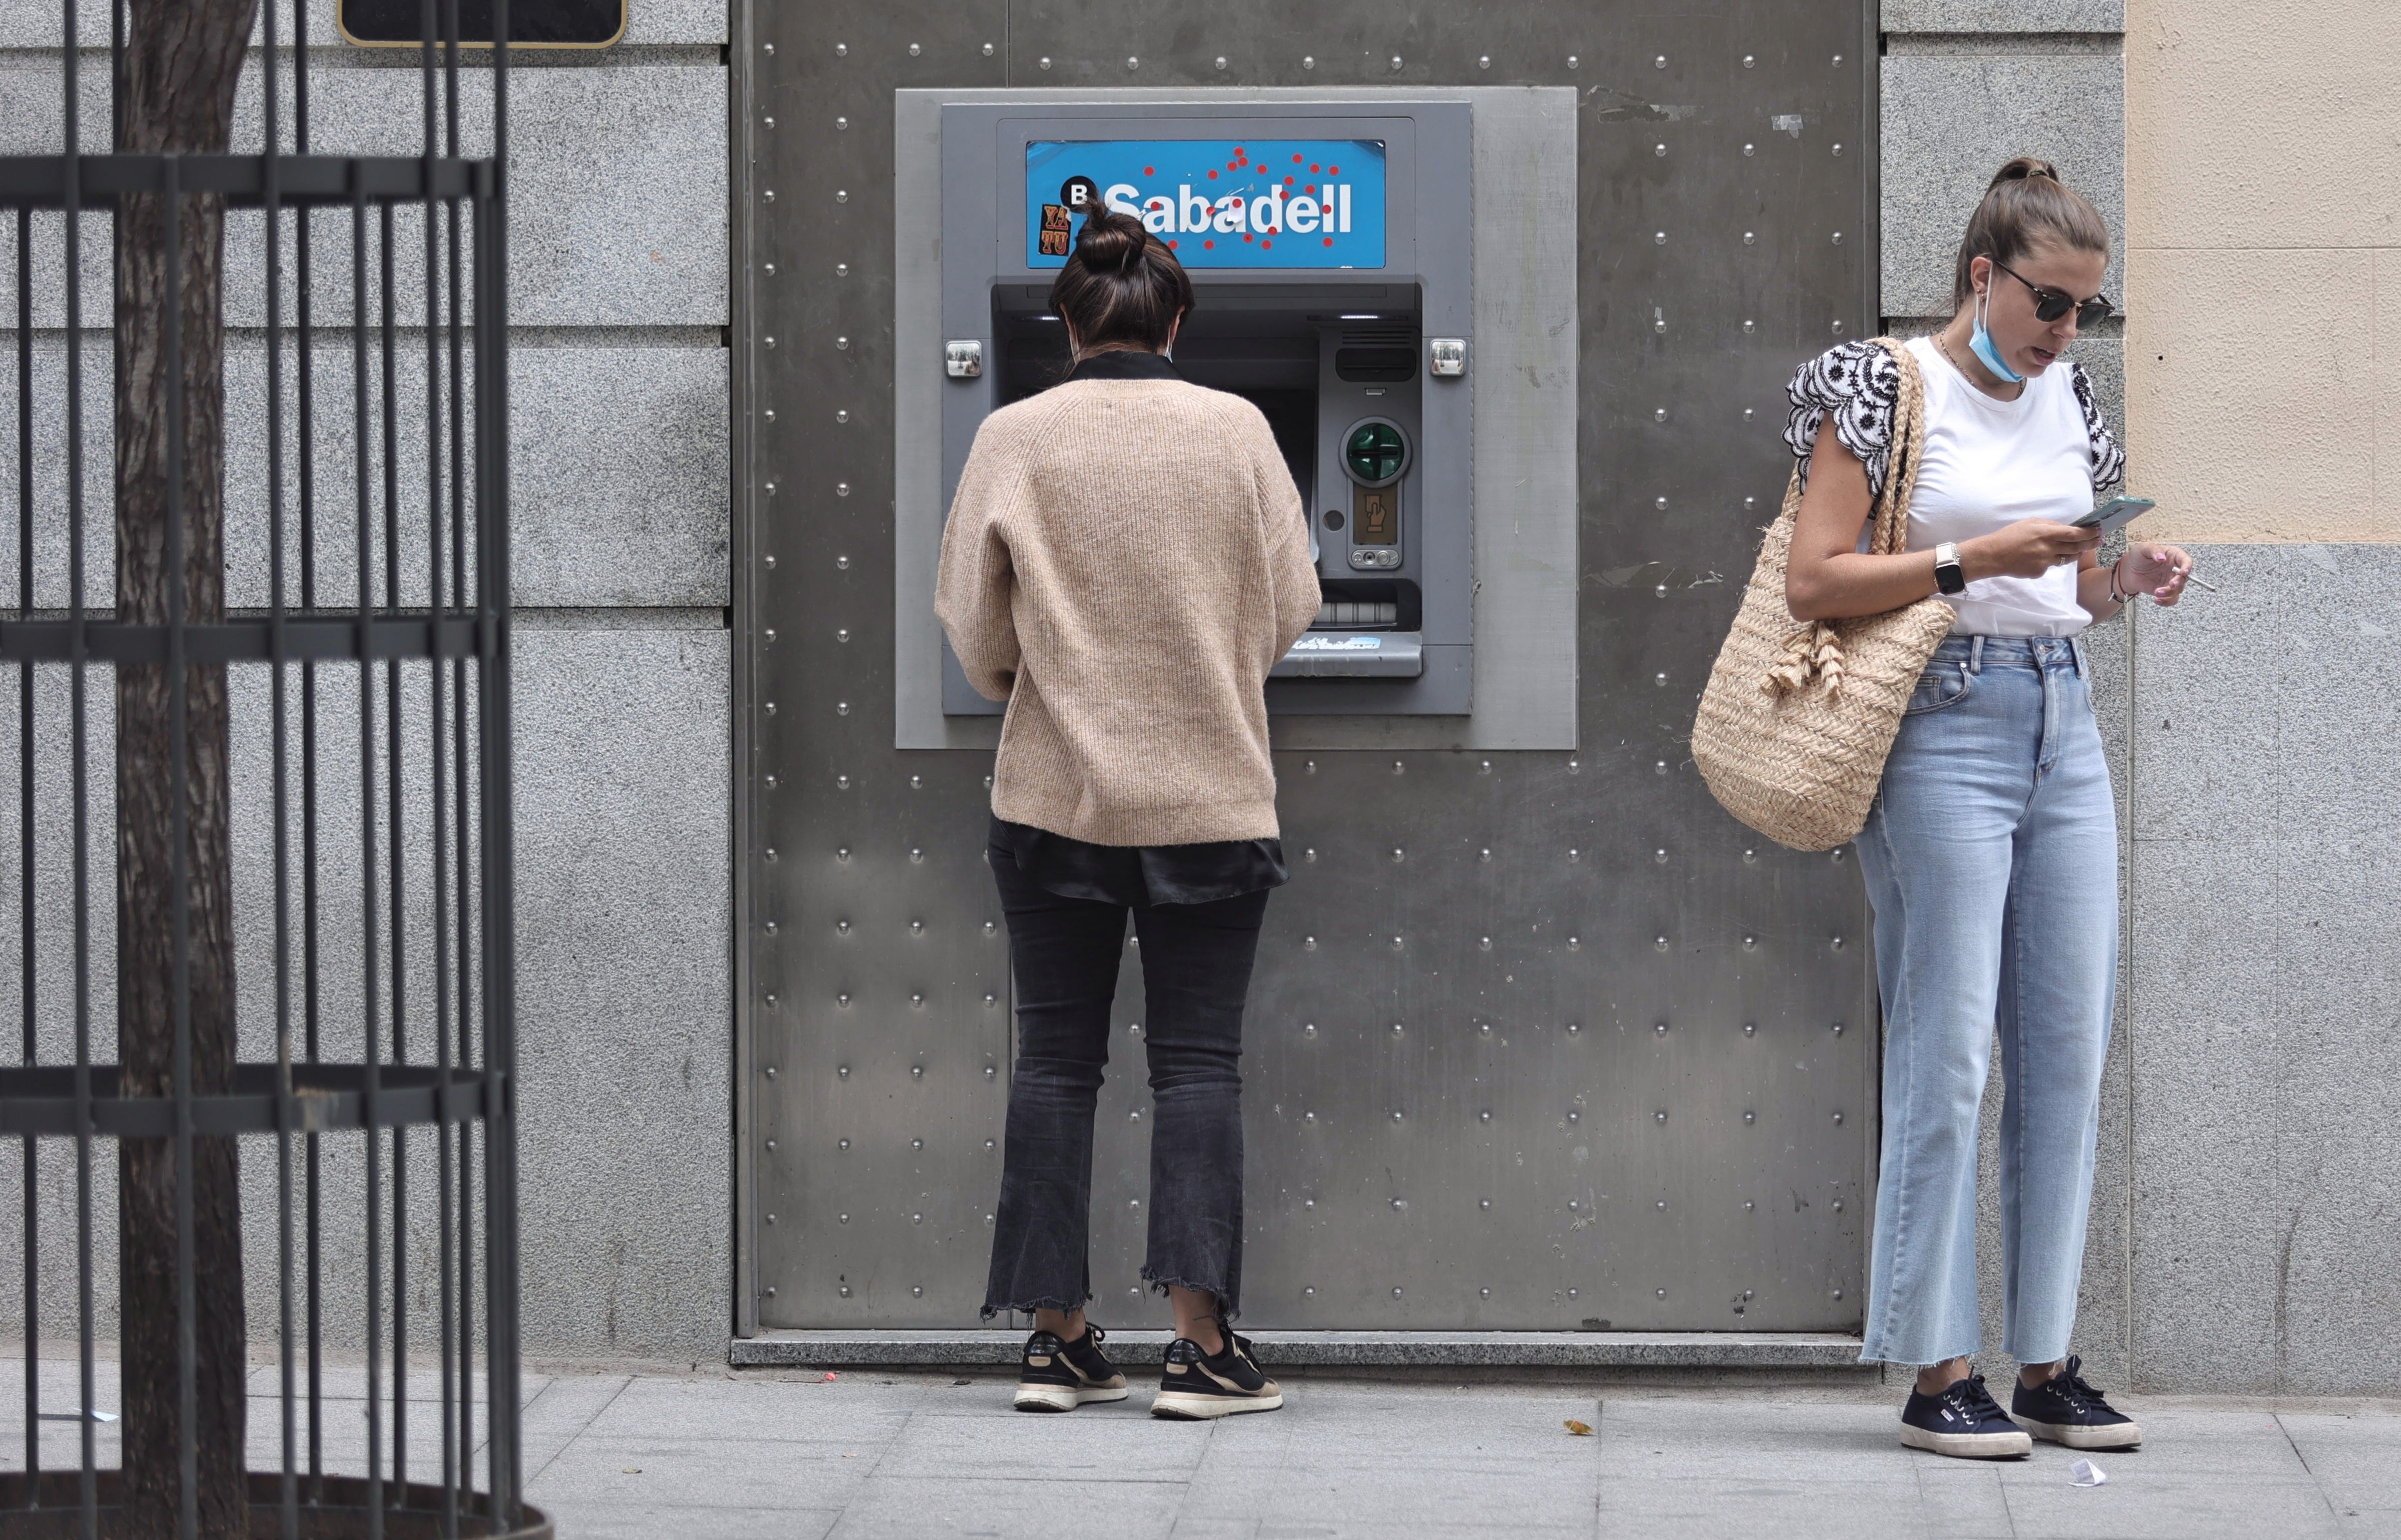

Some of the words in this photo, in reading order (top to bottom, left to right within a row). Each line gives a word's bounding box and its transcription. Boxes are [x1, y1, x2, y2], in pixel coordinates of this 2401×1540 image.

[1044, 206, 1069, 230] YA
[1071, 185, 1088, 205] B
[1104, 184, 1351, 233] Sabadell
[1042, 230, 1069, 255] TU
